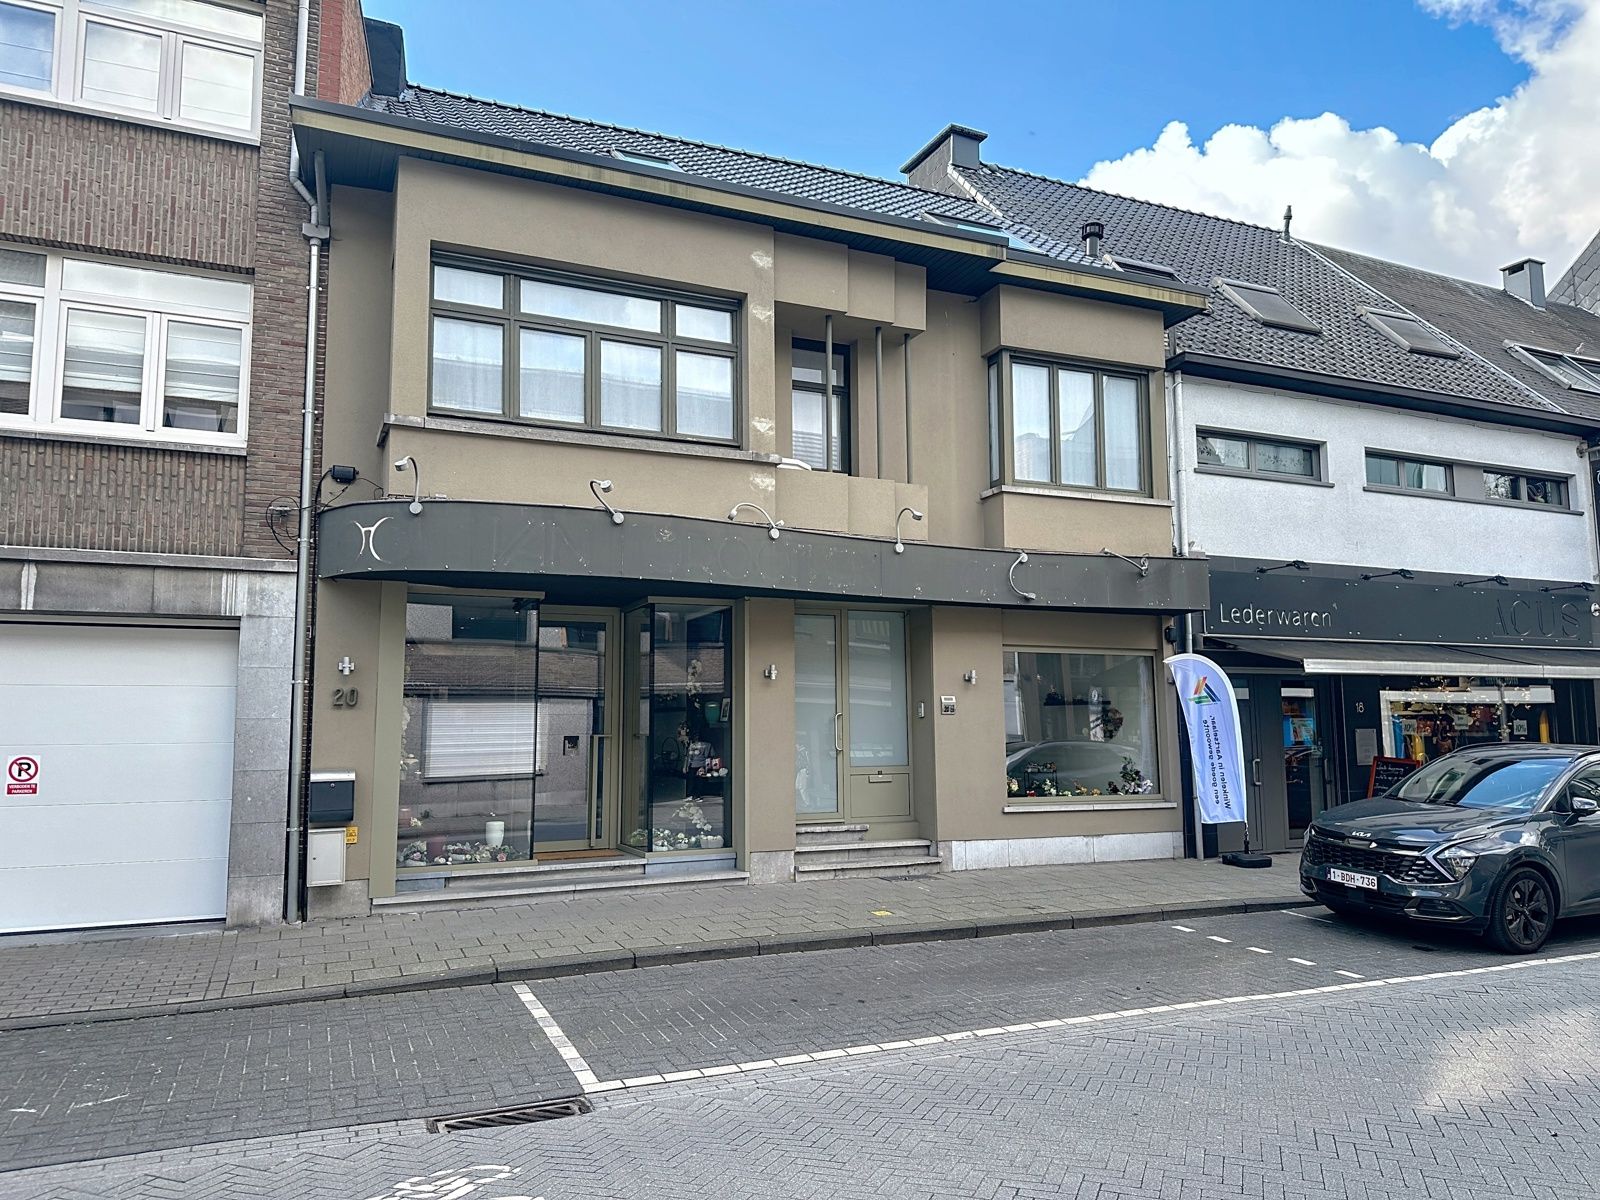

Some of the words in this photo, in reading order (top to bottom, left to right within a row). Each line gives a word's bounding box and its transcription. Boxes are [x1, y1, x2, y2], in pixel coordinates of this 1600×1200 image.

[1220, 602, 1331, 627] Lederwaren
[333, 687, 358, 707] 20
[1355, 702, 1364, 713] 18
[18, 762, 31, 777] P
[1332, 870, 1376, 888] 1-BDH-736
